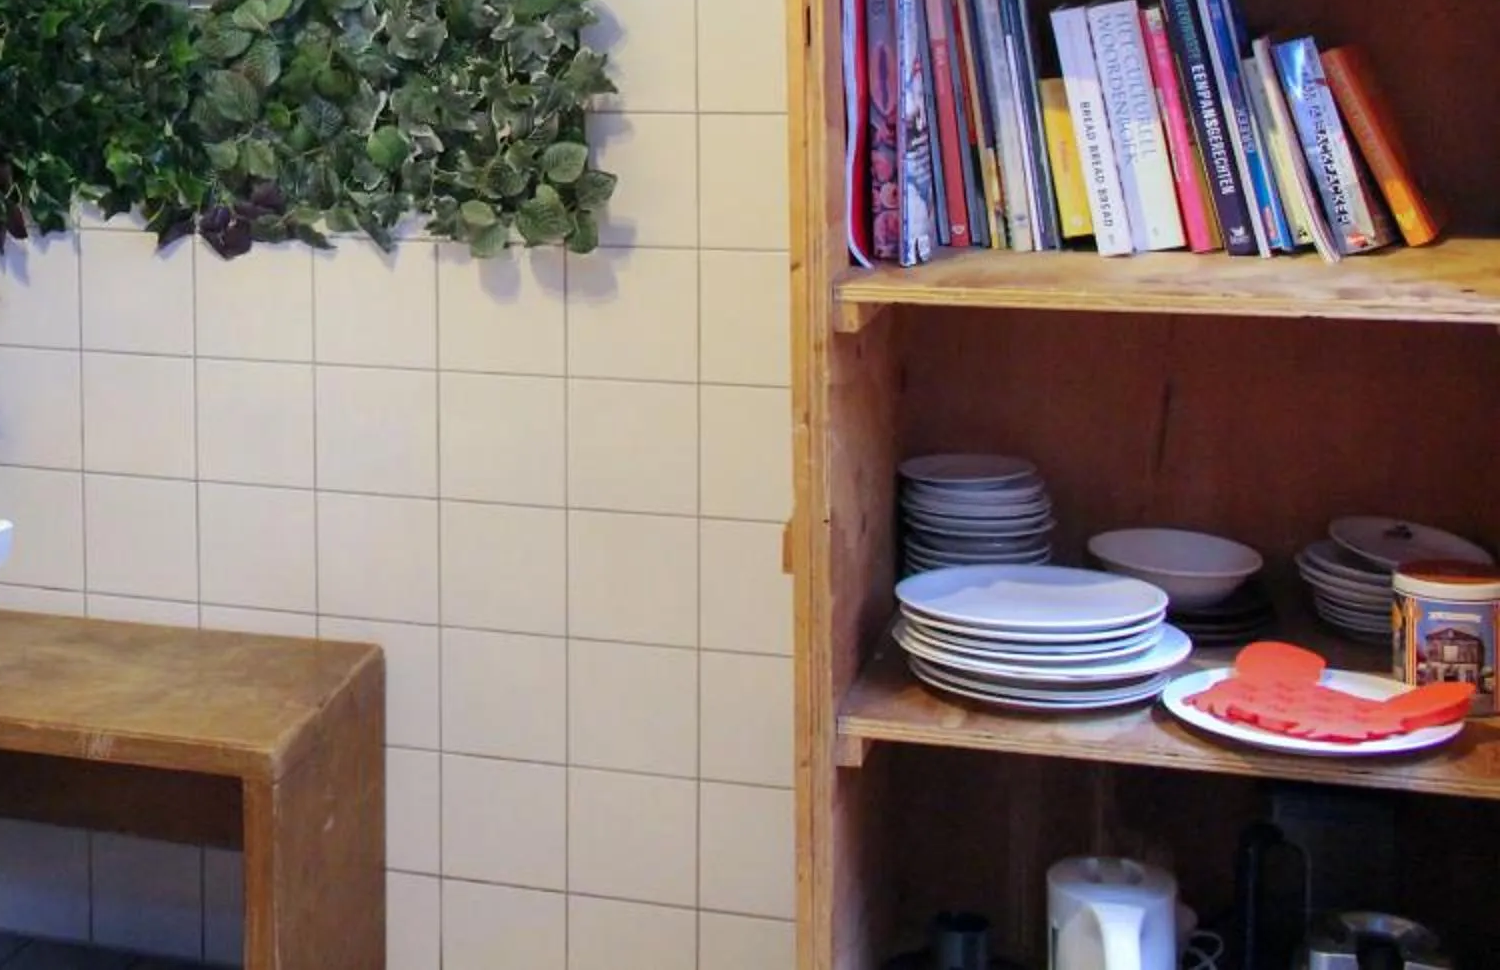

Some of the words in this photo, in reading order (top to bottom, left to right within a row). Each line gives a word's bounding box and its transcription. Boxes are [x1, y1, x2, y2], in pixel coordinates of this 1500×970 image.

[1079, 101, 1096, 142] BREAD
[1088, 144, 1105, 186] BREAD
[1097, 188, 1114, 228] BREAD
[1190, 63, 1237, 196] EENPANSGERECHTEN
